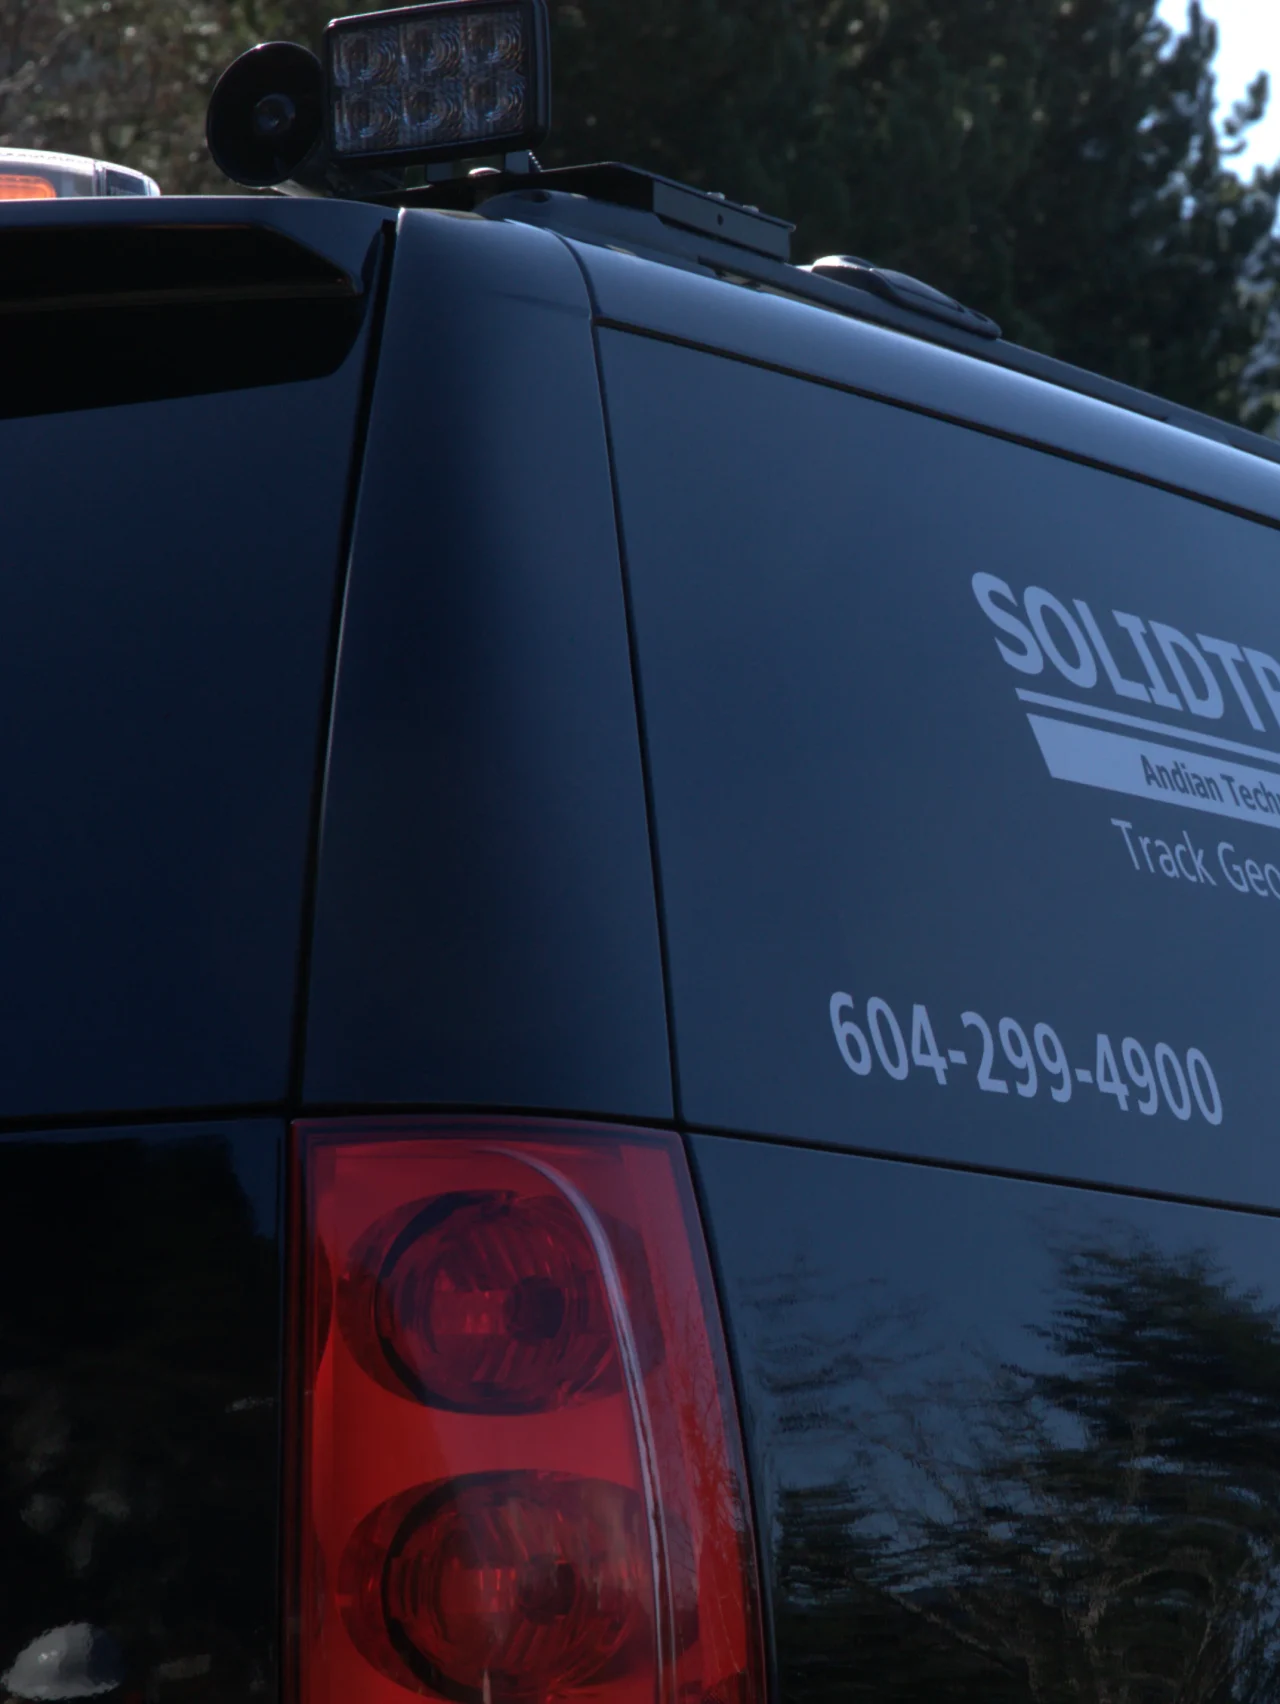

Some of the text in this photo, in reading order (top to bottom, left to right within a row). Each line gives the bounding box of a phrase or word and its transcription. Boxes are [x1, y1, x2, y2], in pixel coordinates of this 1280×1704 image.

[1141, 754, 1221, 803] Andian
[1110, 817, 1213, 887] Track
[829, 991, 1223, 1126] 604-299-4900
